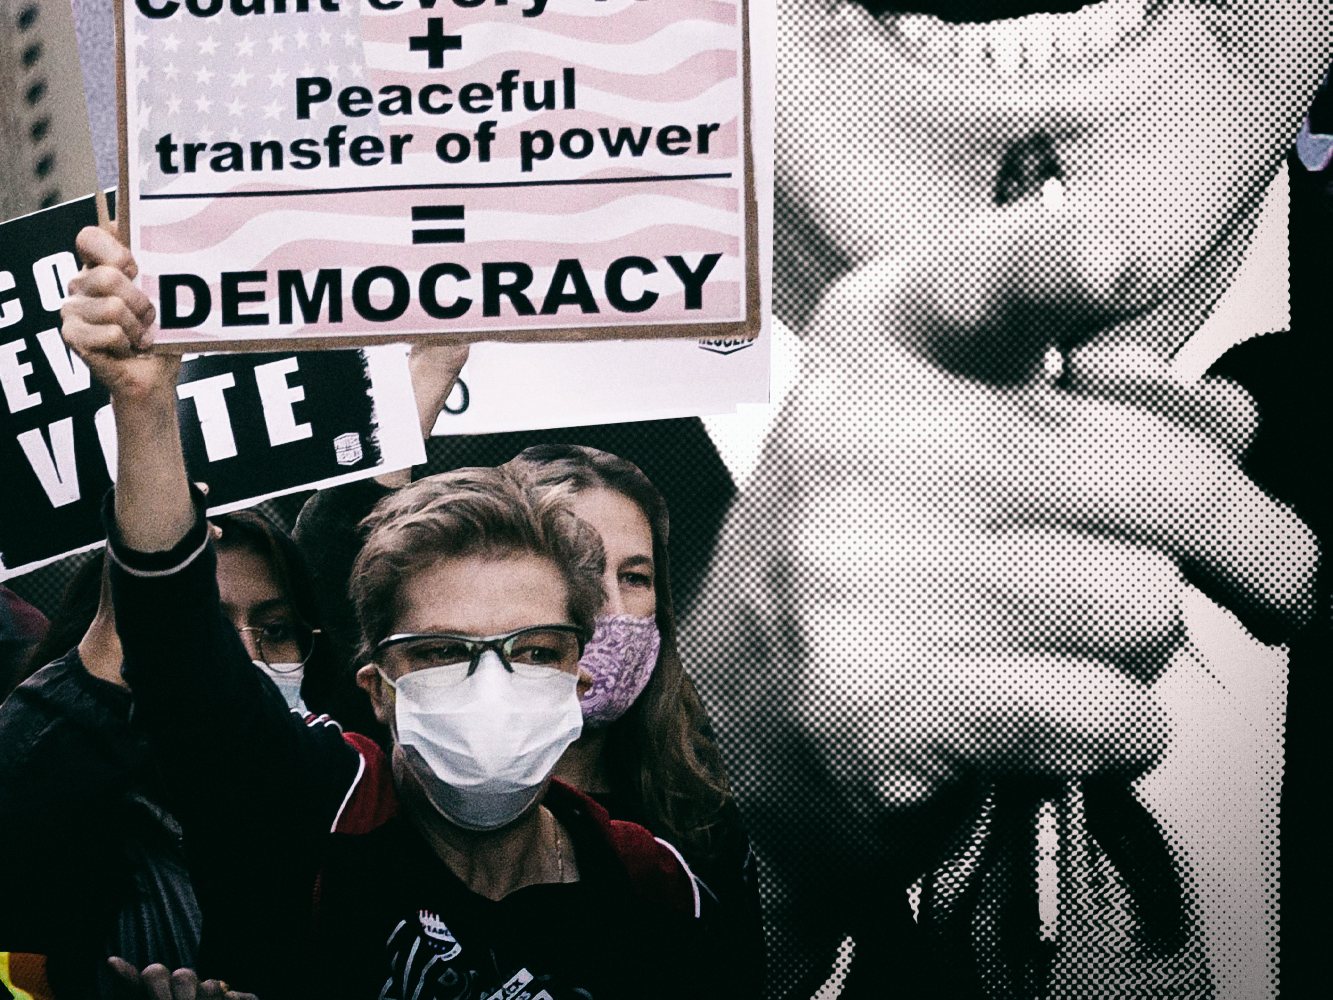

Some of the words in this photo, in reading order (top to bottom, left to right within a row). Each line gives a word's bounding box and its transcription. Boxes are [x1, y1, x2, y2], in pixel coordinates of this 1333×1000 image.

[294, 67, 577, 121] Peaceful
[154, 124, 412, 175] transfer
[434, 122, 500, 165] of
[520, 119, 721, 172] power
[156, 252, 725, 331] DEMOCRACY
